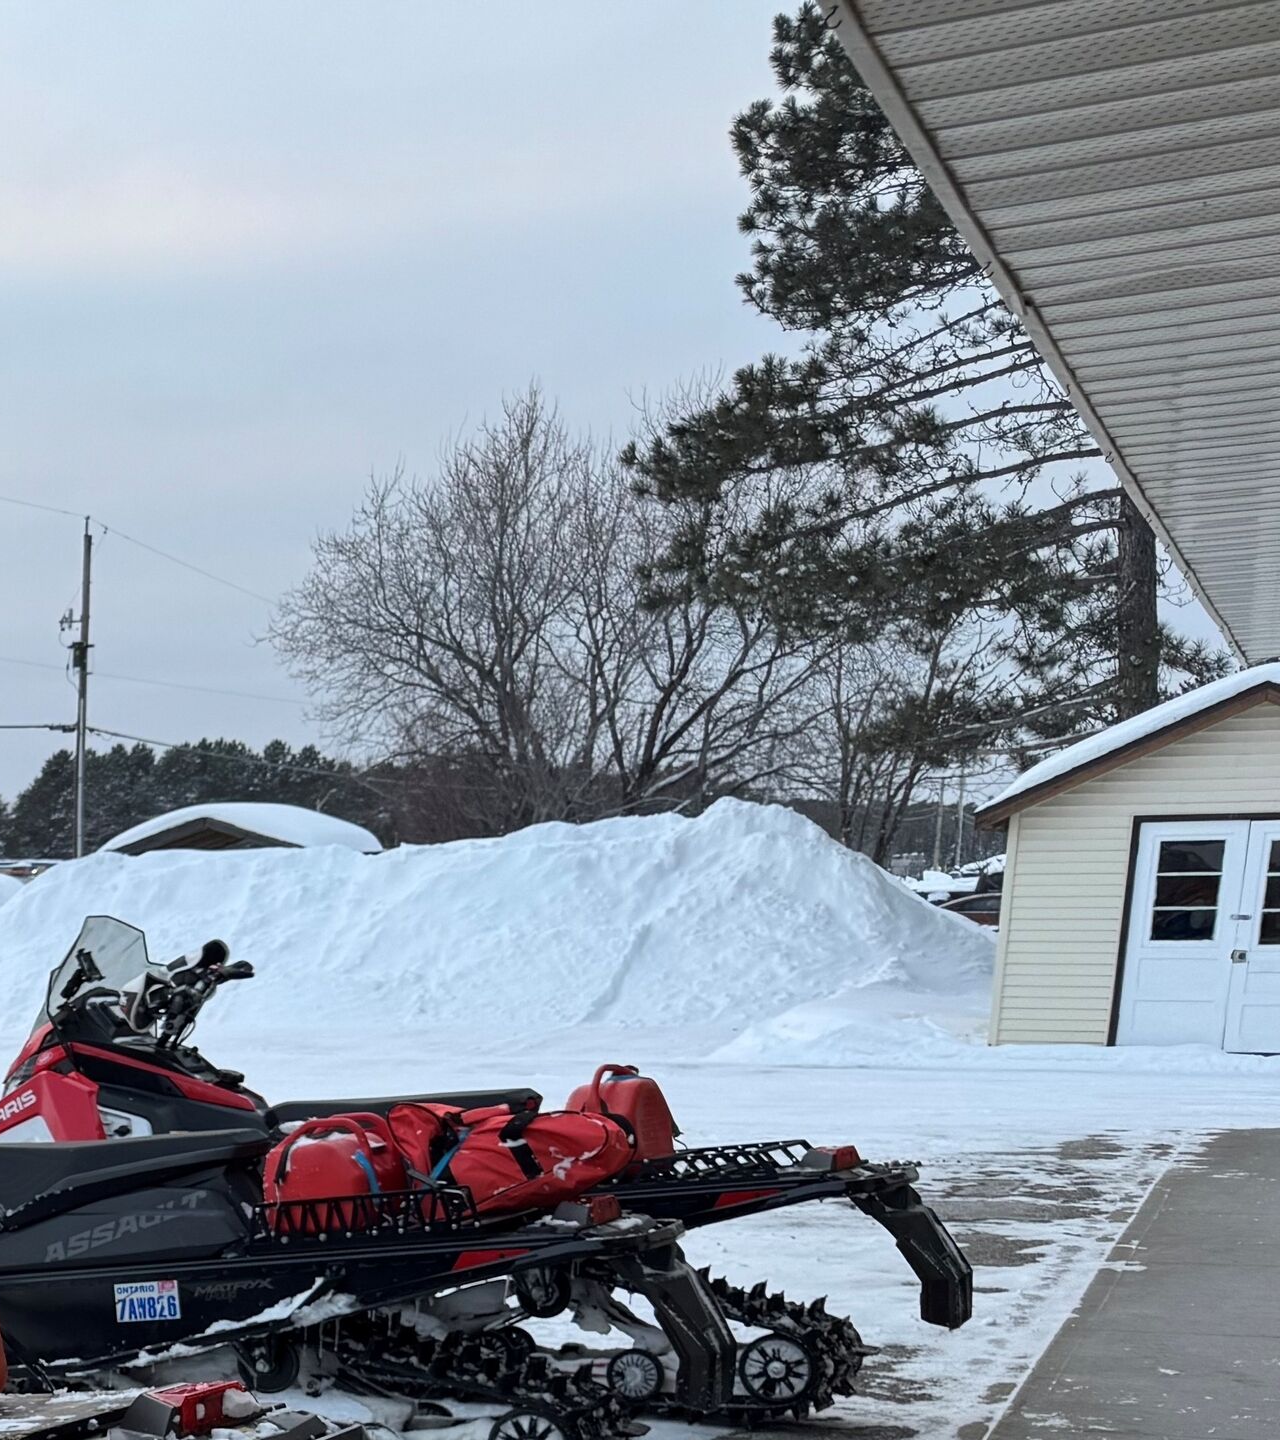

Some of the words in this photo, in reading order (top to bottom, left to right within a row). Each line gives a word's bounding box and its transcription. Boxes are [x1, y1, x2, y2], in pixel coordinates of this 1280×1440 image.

[44, 1189, 208, 1263] ASSAULT
[116, 1284, 155, 1295] ONTARIO
[193, 1277, 275, 1298] MATRYX
[117, 1295, 178, 1321] 7AW826
